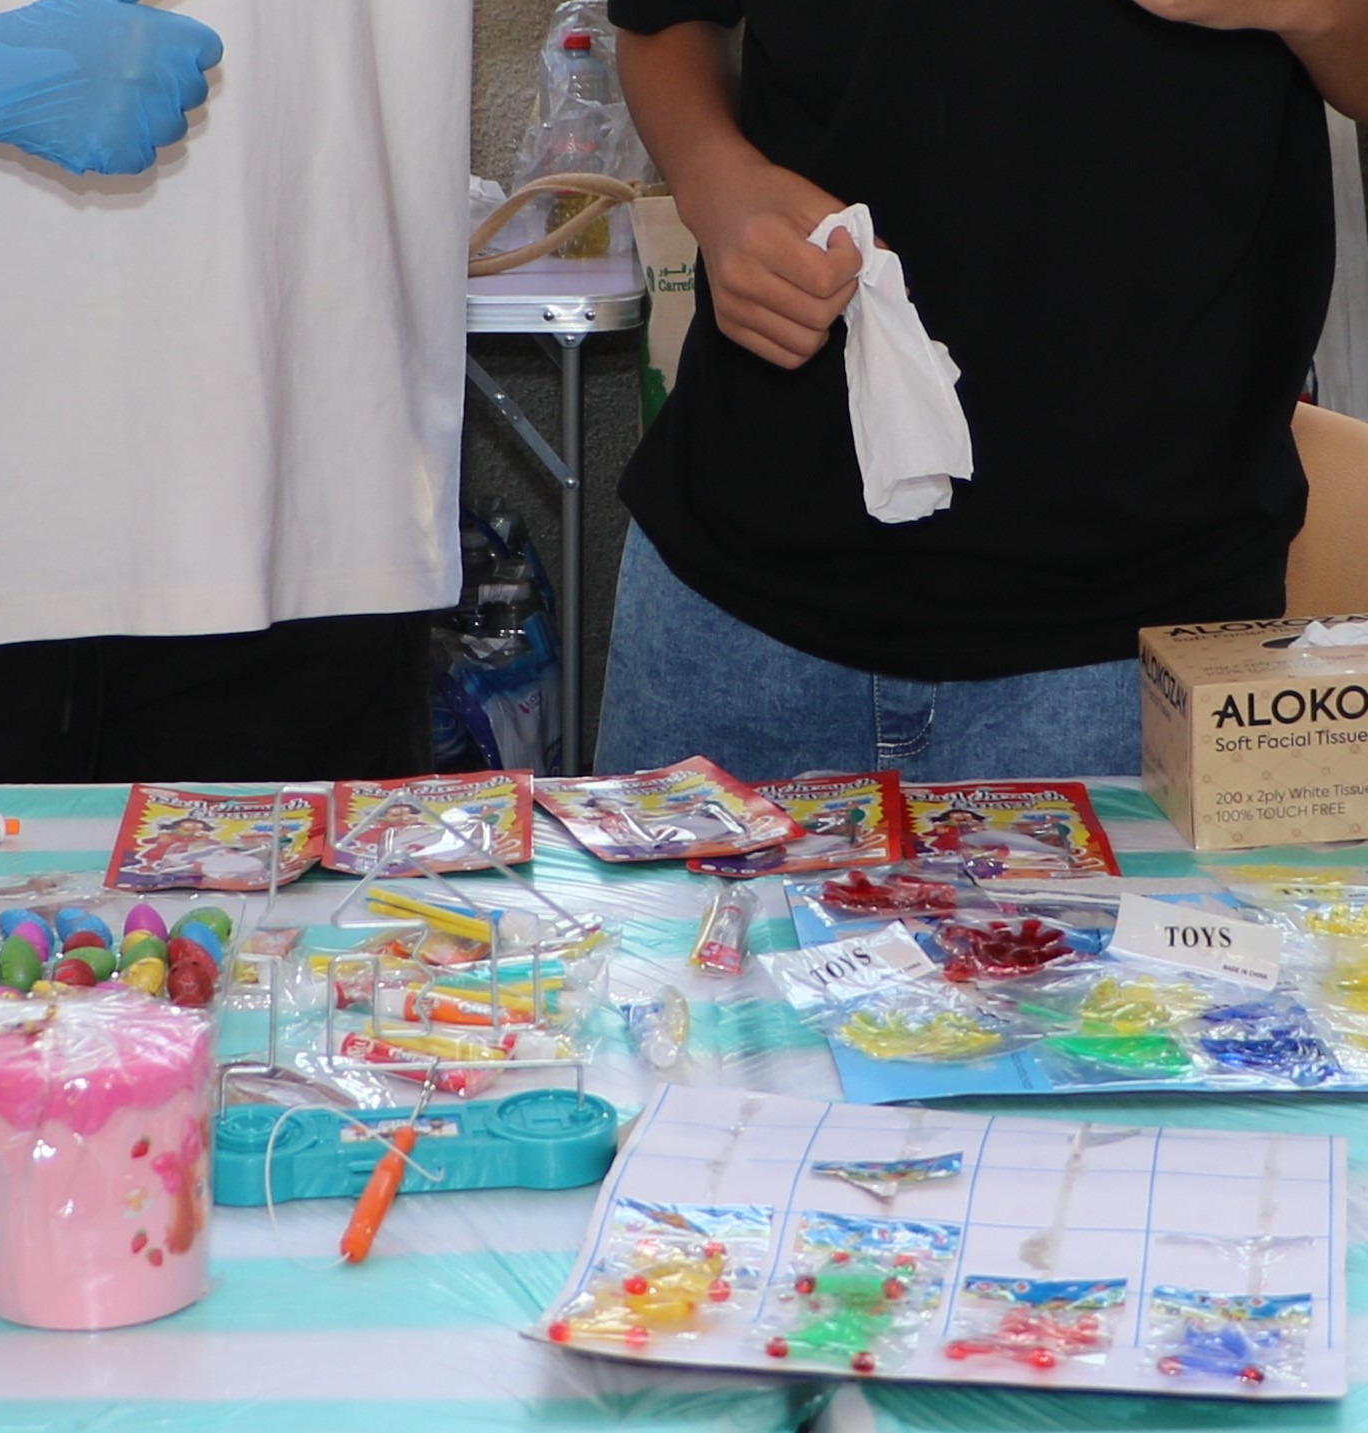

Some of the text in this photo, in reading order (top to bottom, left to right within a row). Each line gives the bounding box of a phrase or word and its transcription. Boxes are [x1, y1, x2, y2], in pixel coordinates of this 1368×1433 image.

[658, 277, 695, 292] Carref
[1214, 735, 1253, 753] Soft
[1257, 731, 1312, 750] Facial
[1215, 791, 1243, 806] 200
[1246, 793, 1254, 804] x
[1257, 789, 1286, 805] 2ply
[1288, 786, 1330, 800] White
[1215, 802, 1346, 824] 100% TOUCH FREE
[1164, 926, 1232, 948] TOYS
[809, 947, 872, 986] TOYS
[1222, 963, 1239, 973] MADE
[1248, 969, 1268, 979] CHINA
